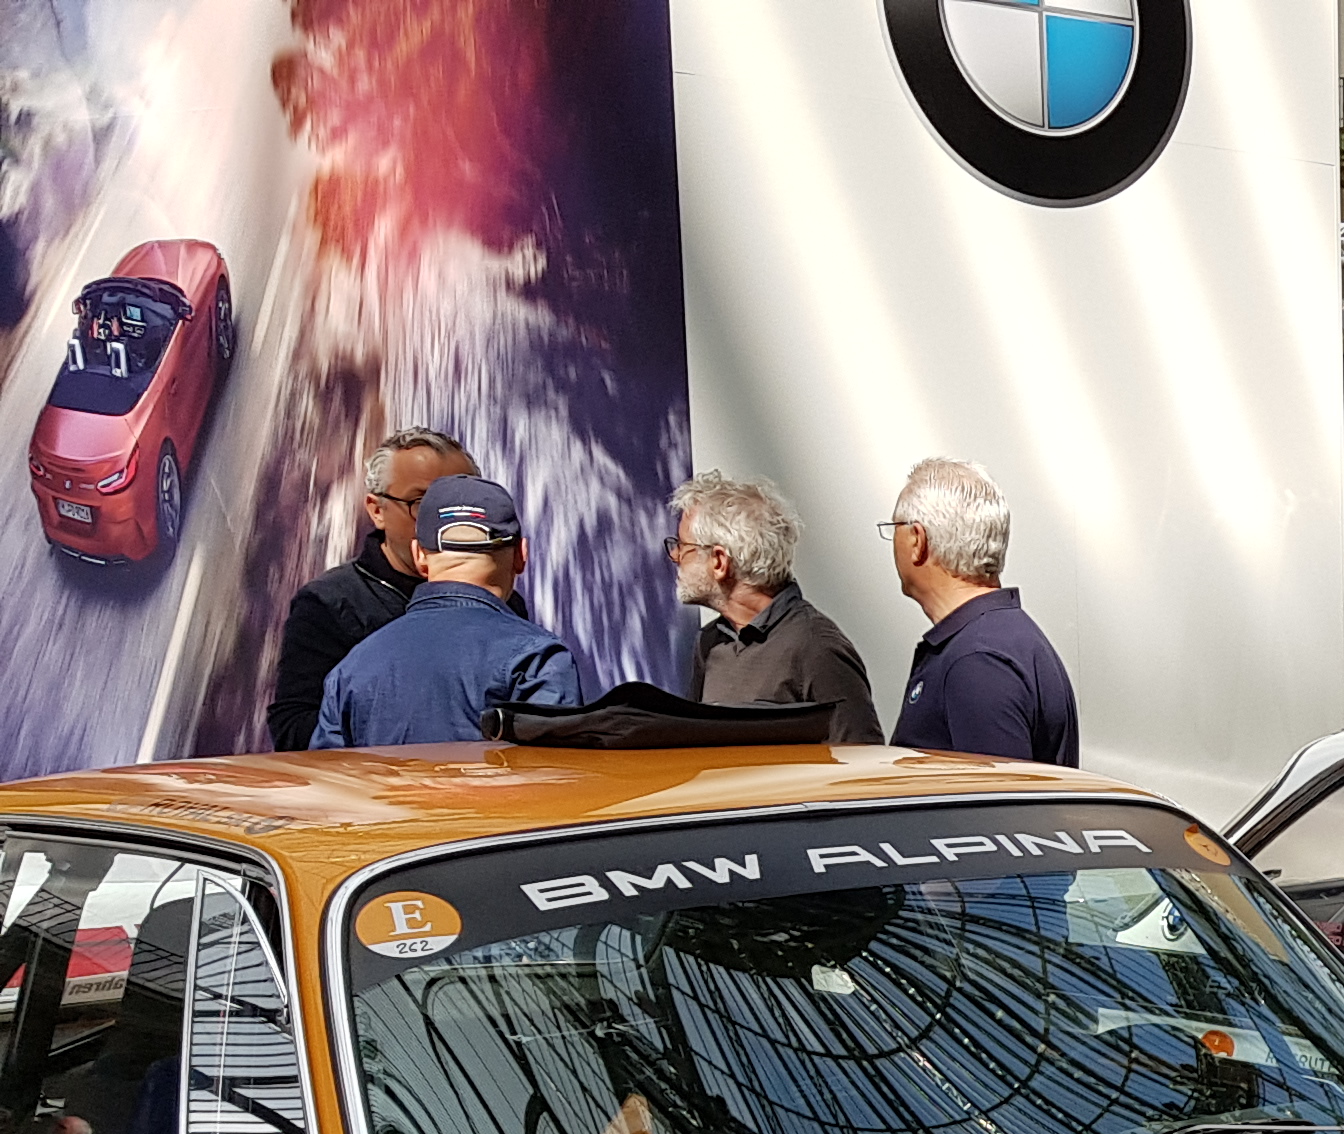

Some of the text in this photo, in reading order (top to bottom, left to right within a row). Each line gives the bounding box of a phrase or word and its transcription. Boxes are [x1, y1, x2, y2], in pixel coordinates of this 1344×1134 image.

[520, 829, 1152, 911] BMW ALPINA
[388, 901, 432, 935] E
[394, 940, 434, 956] 262
